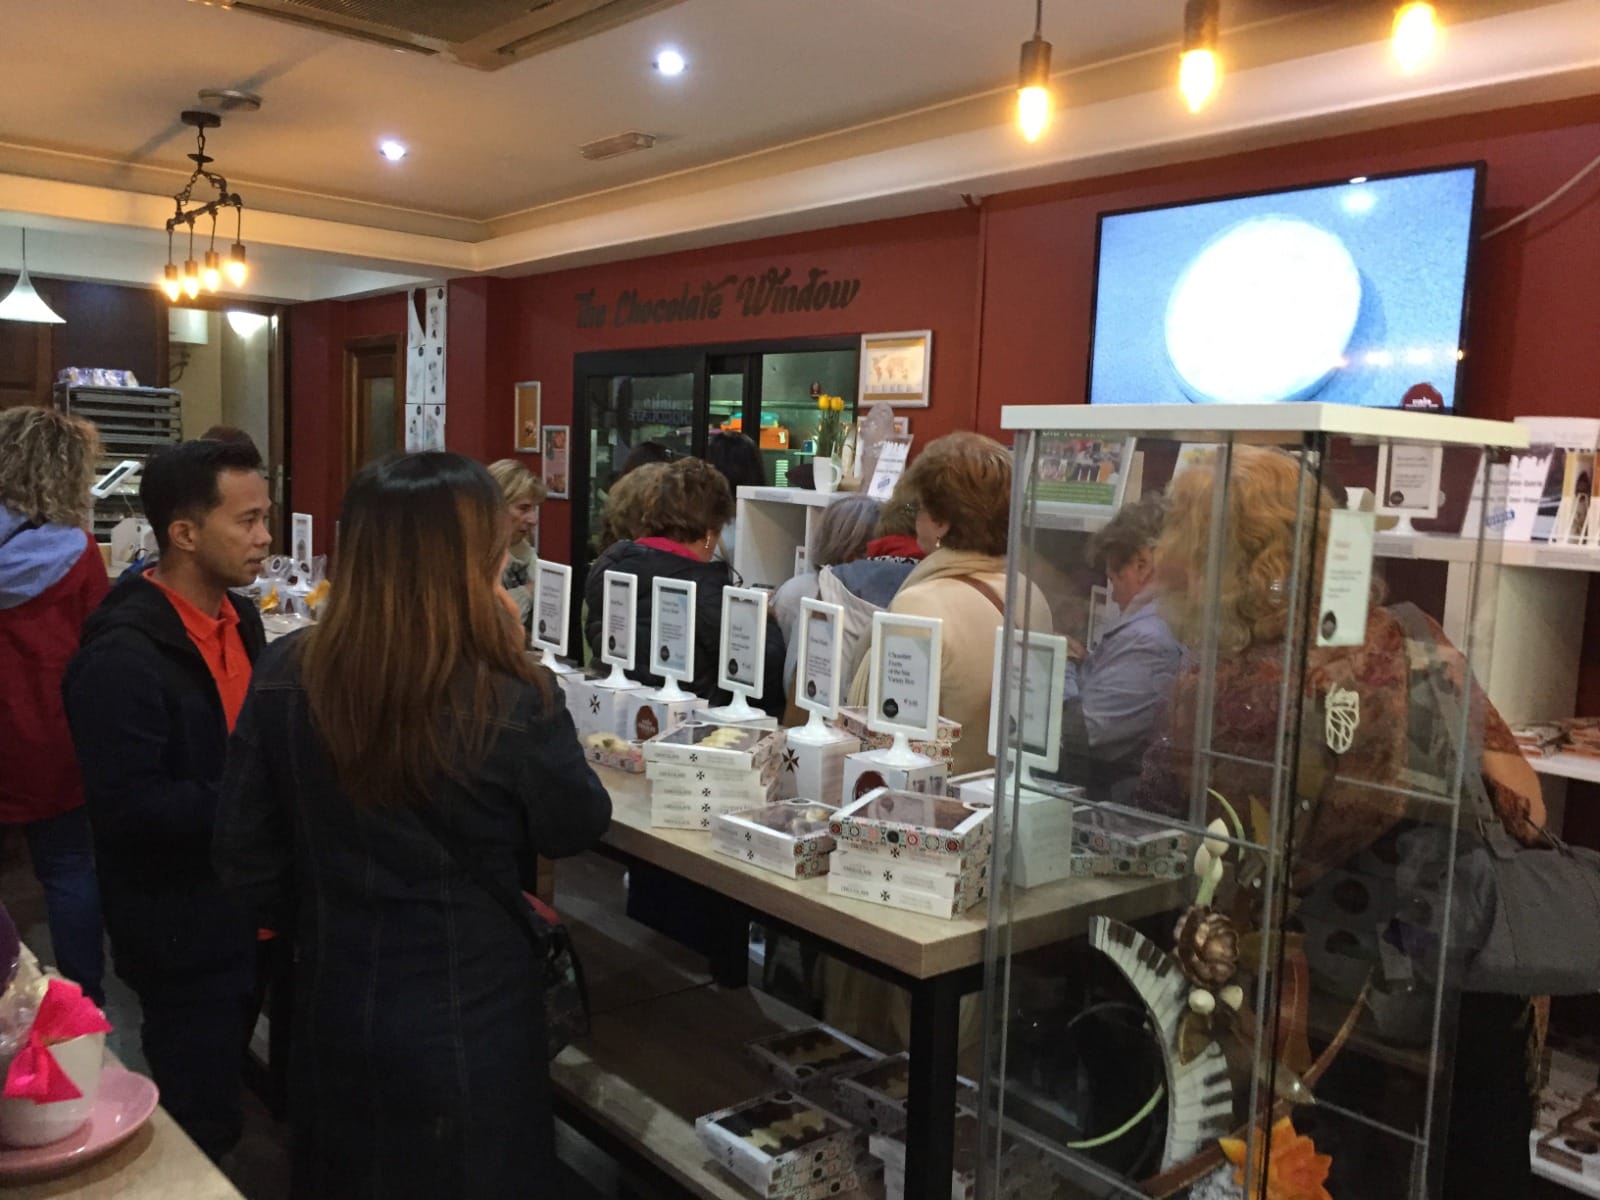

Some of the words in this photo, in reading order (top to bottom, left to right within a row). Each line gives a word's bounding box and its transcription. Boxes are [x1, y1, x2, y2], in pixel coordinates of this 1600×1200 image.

[575, 288, 607, 328] The
[614, 274, 737, 328] Chocolate
[736, 266, 860, 317] Window
